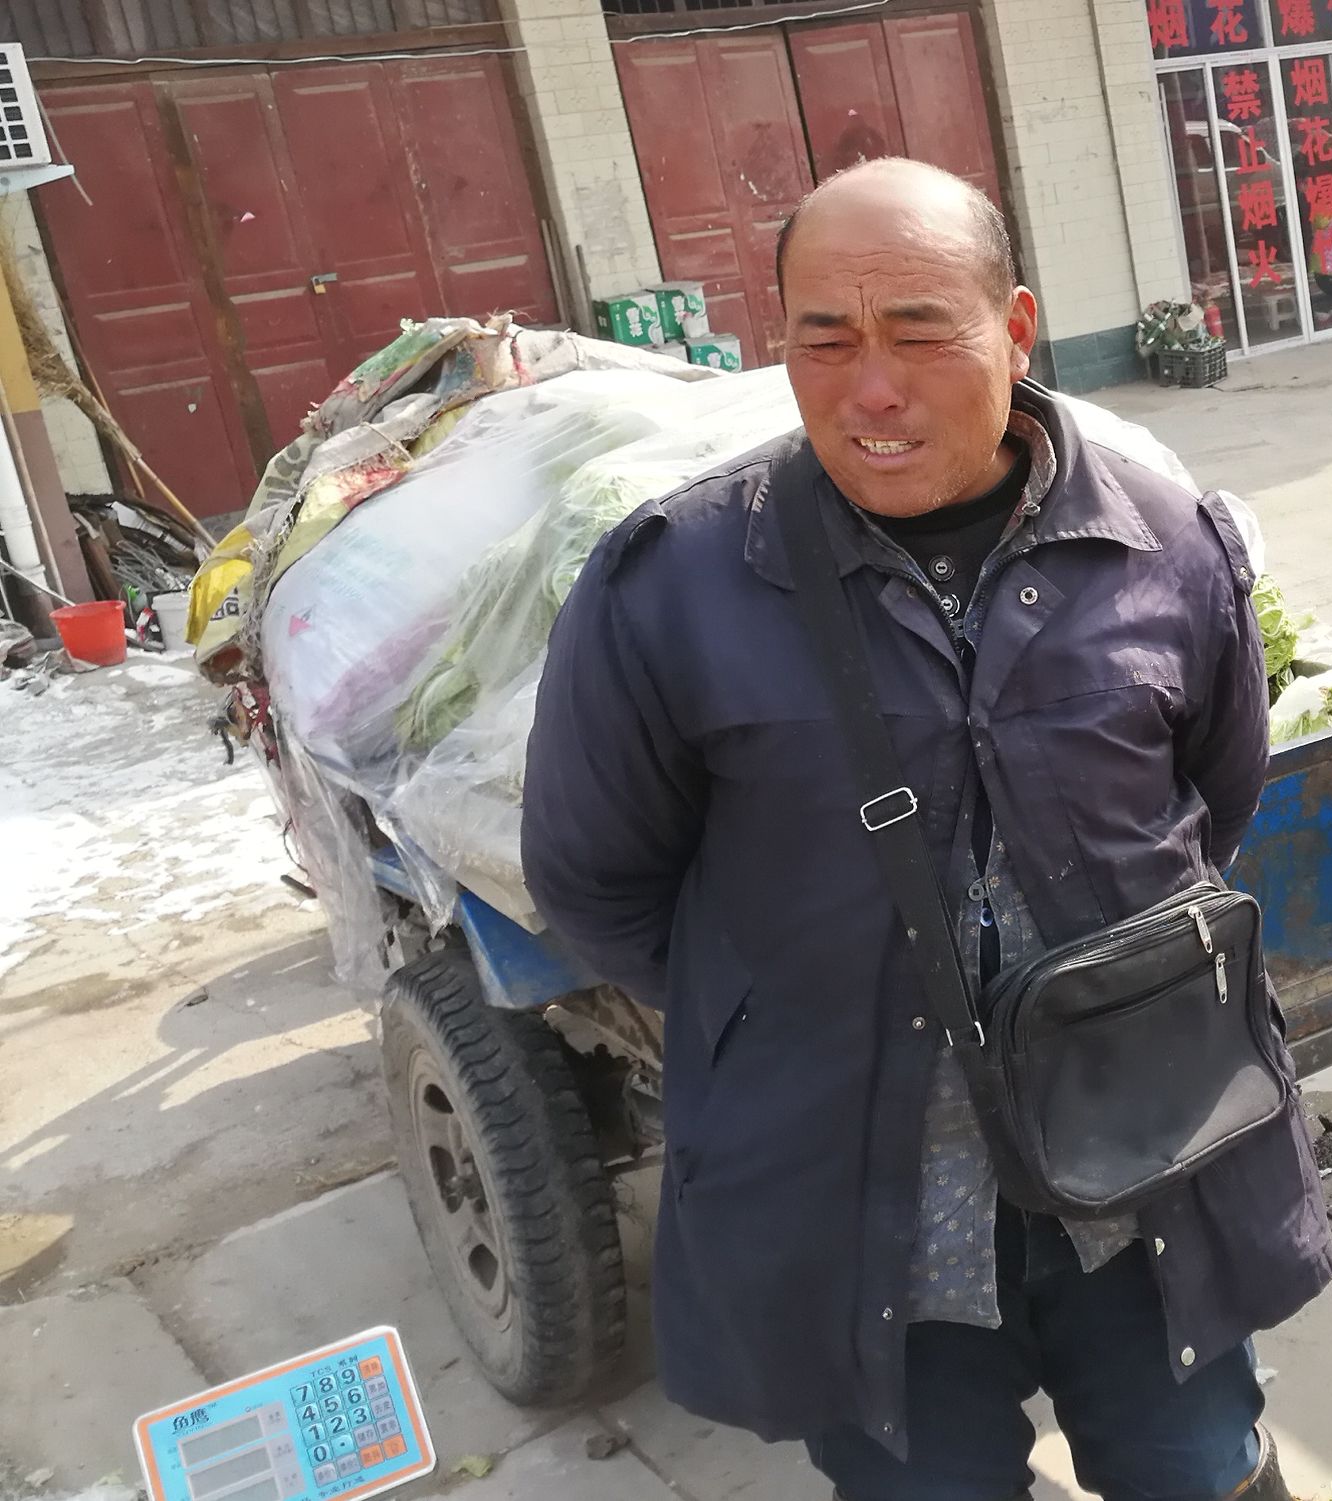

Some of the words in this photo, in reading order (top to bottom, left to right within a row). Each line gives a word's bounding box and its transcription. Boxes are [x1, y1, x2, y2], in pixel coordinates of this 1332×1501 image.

[1221, 69, 1282, 289] 禁止烟火
[296, 1385, 308, 1402] 7
[319, 1377, 334, 1393] 8
[341, 1368, 356, 1385] 9
[302, 1405, 316, 1422] 4
[324, 1397, 339, 1413] 5
[347, 1388, 362, 1404] 6
[308, 1426, 320, 1441] 1
[330, 1417, 346, 1434] 2
[353, 1408, 367, 1424] 3
[313, 1446, 327, 1462] 0
